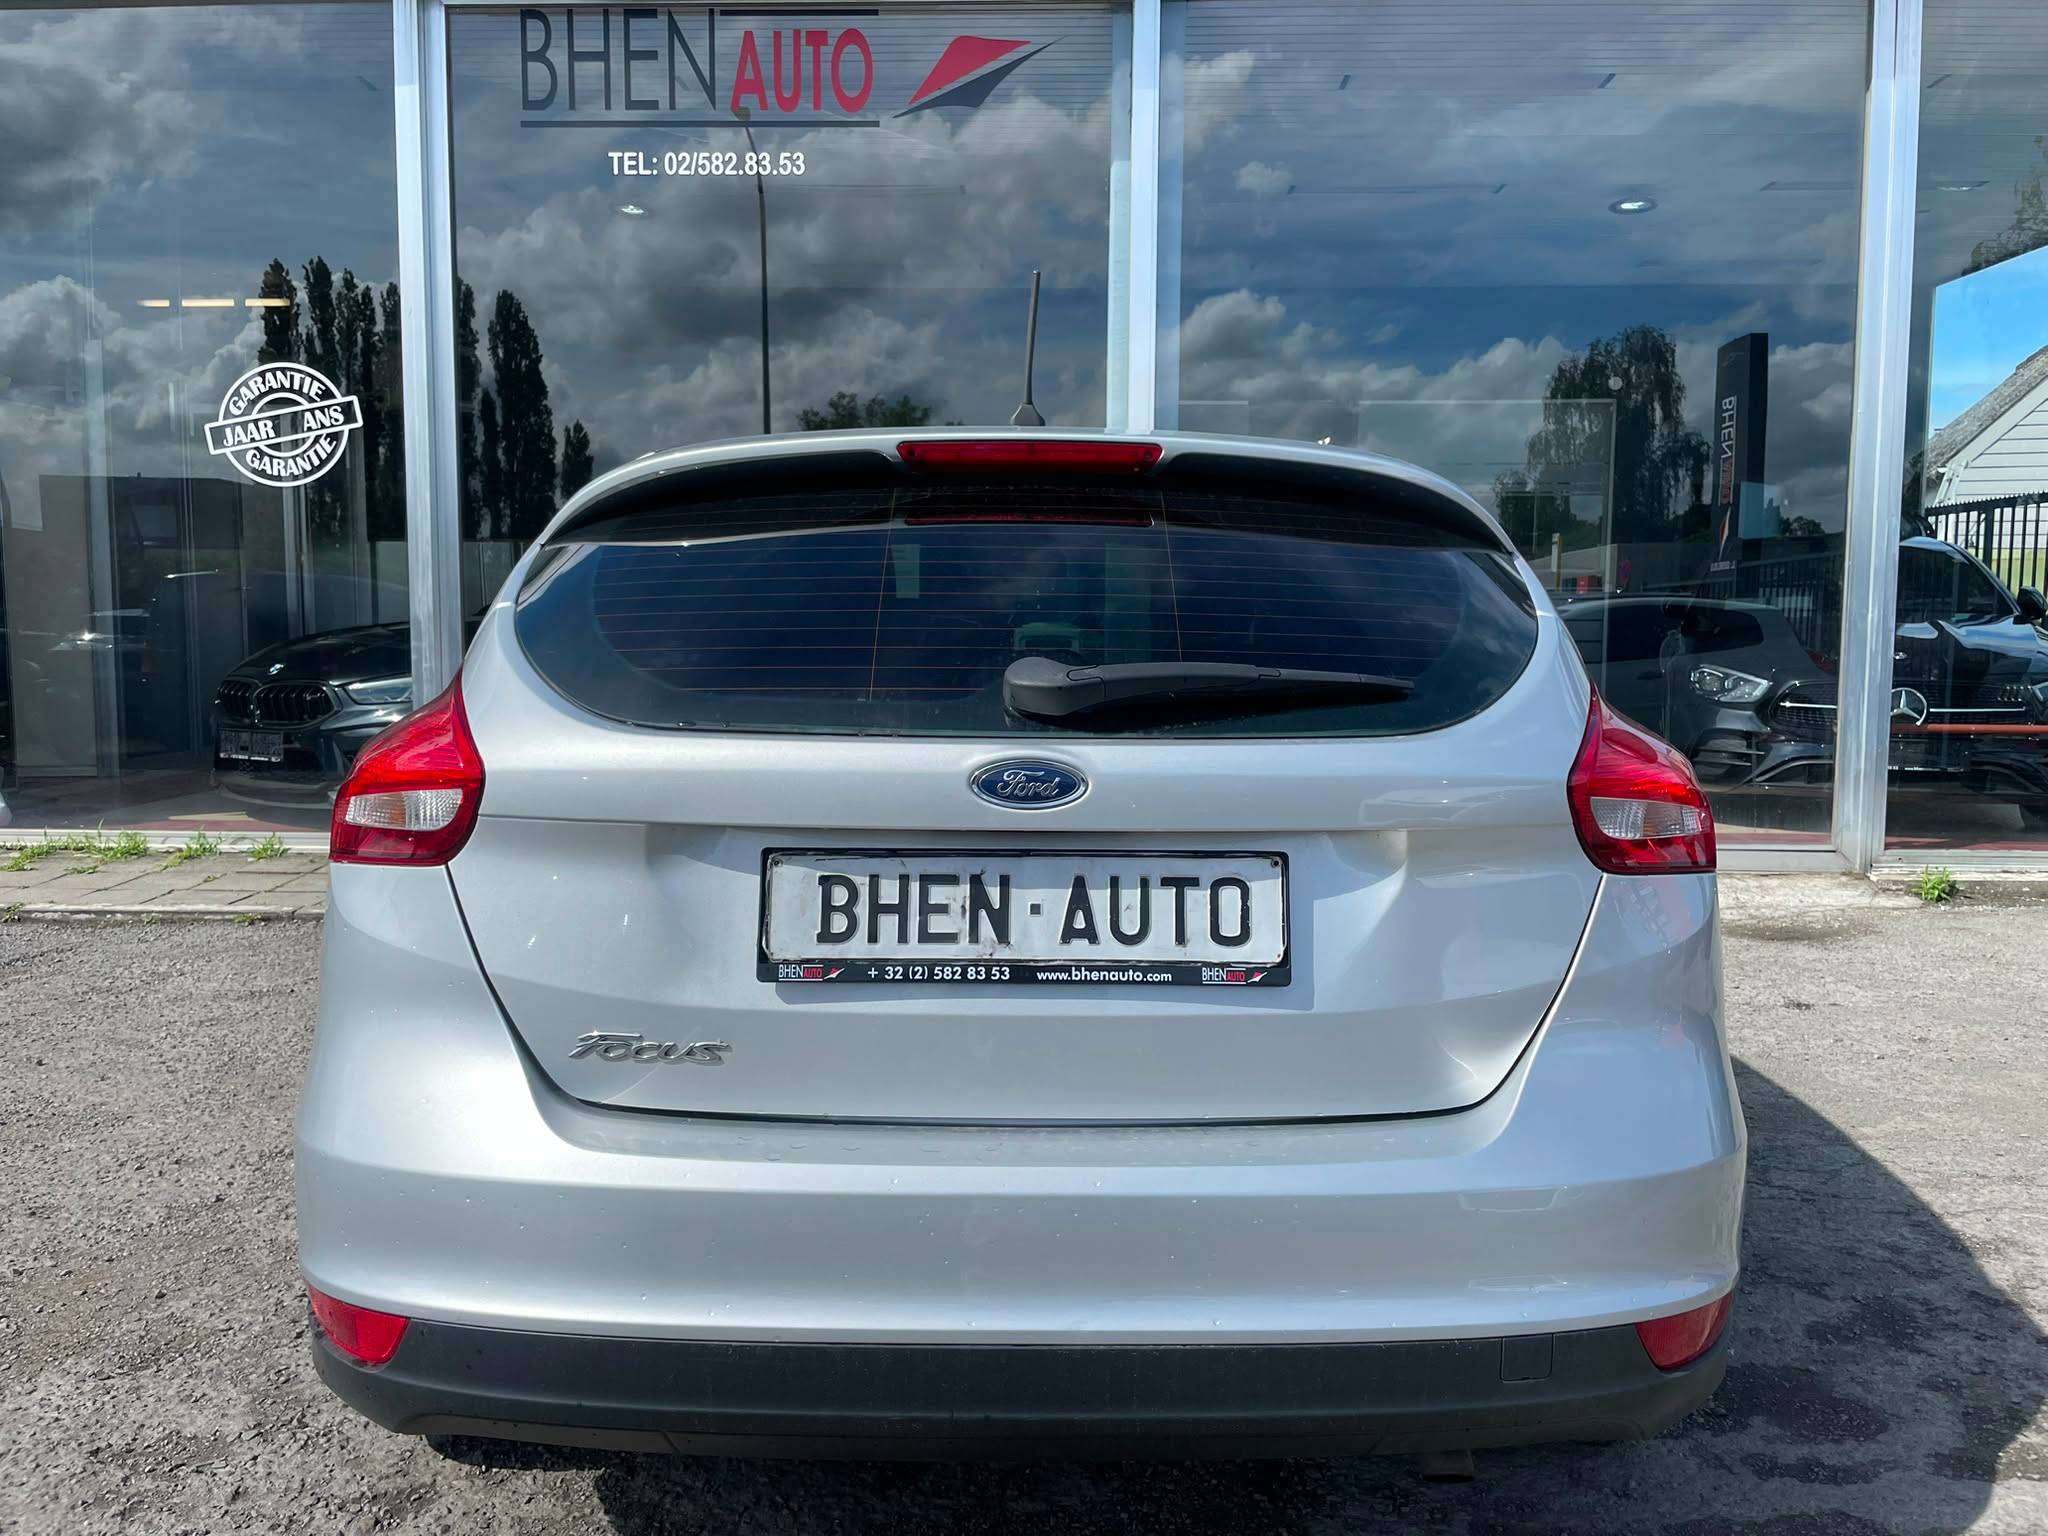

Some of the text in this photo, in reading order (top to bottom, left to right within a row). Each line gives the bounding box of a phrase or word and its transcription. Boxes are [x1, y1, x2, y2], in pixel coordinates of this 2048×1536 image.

[520, 8, 873, 113] BHEN AUTO
[608, 151, 806, 177] TEL: 02/582.83.53
[229, 370, 326, 416] GARANTIE
[223, 406, 345, 447] JAAR ANS
[245, 433, 336, 477] GARANTIE
[996, 769, 1060, 797] Ford
[816, 873, 1011, 945] BHEN
[1059, 875, 1252, 947] AUTO
[884, 966, 904, 980] 32
[908, 966, 929, 981] (2)
[933, 966, 962, 981] 582
[966, 967, 986, 980] 83
[990, 967, 1011, 980] 53
[1036, 967, 1173, 982] www.bhenauto.com
[569, 1031, 733, 1066] Focus
